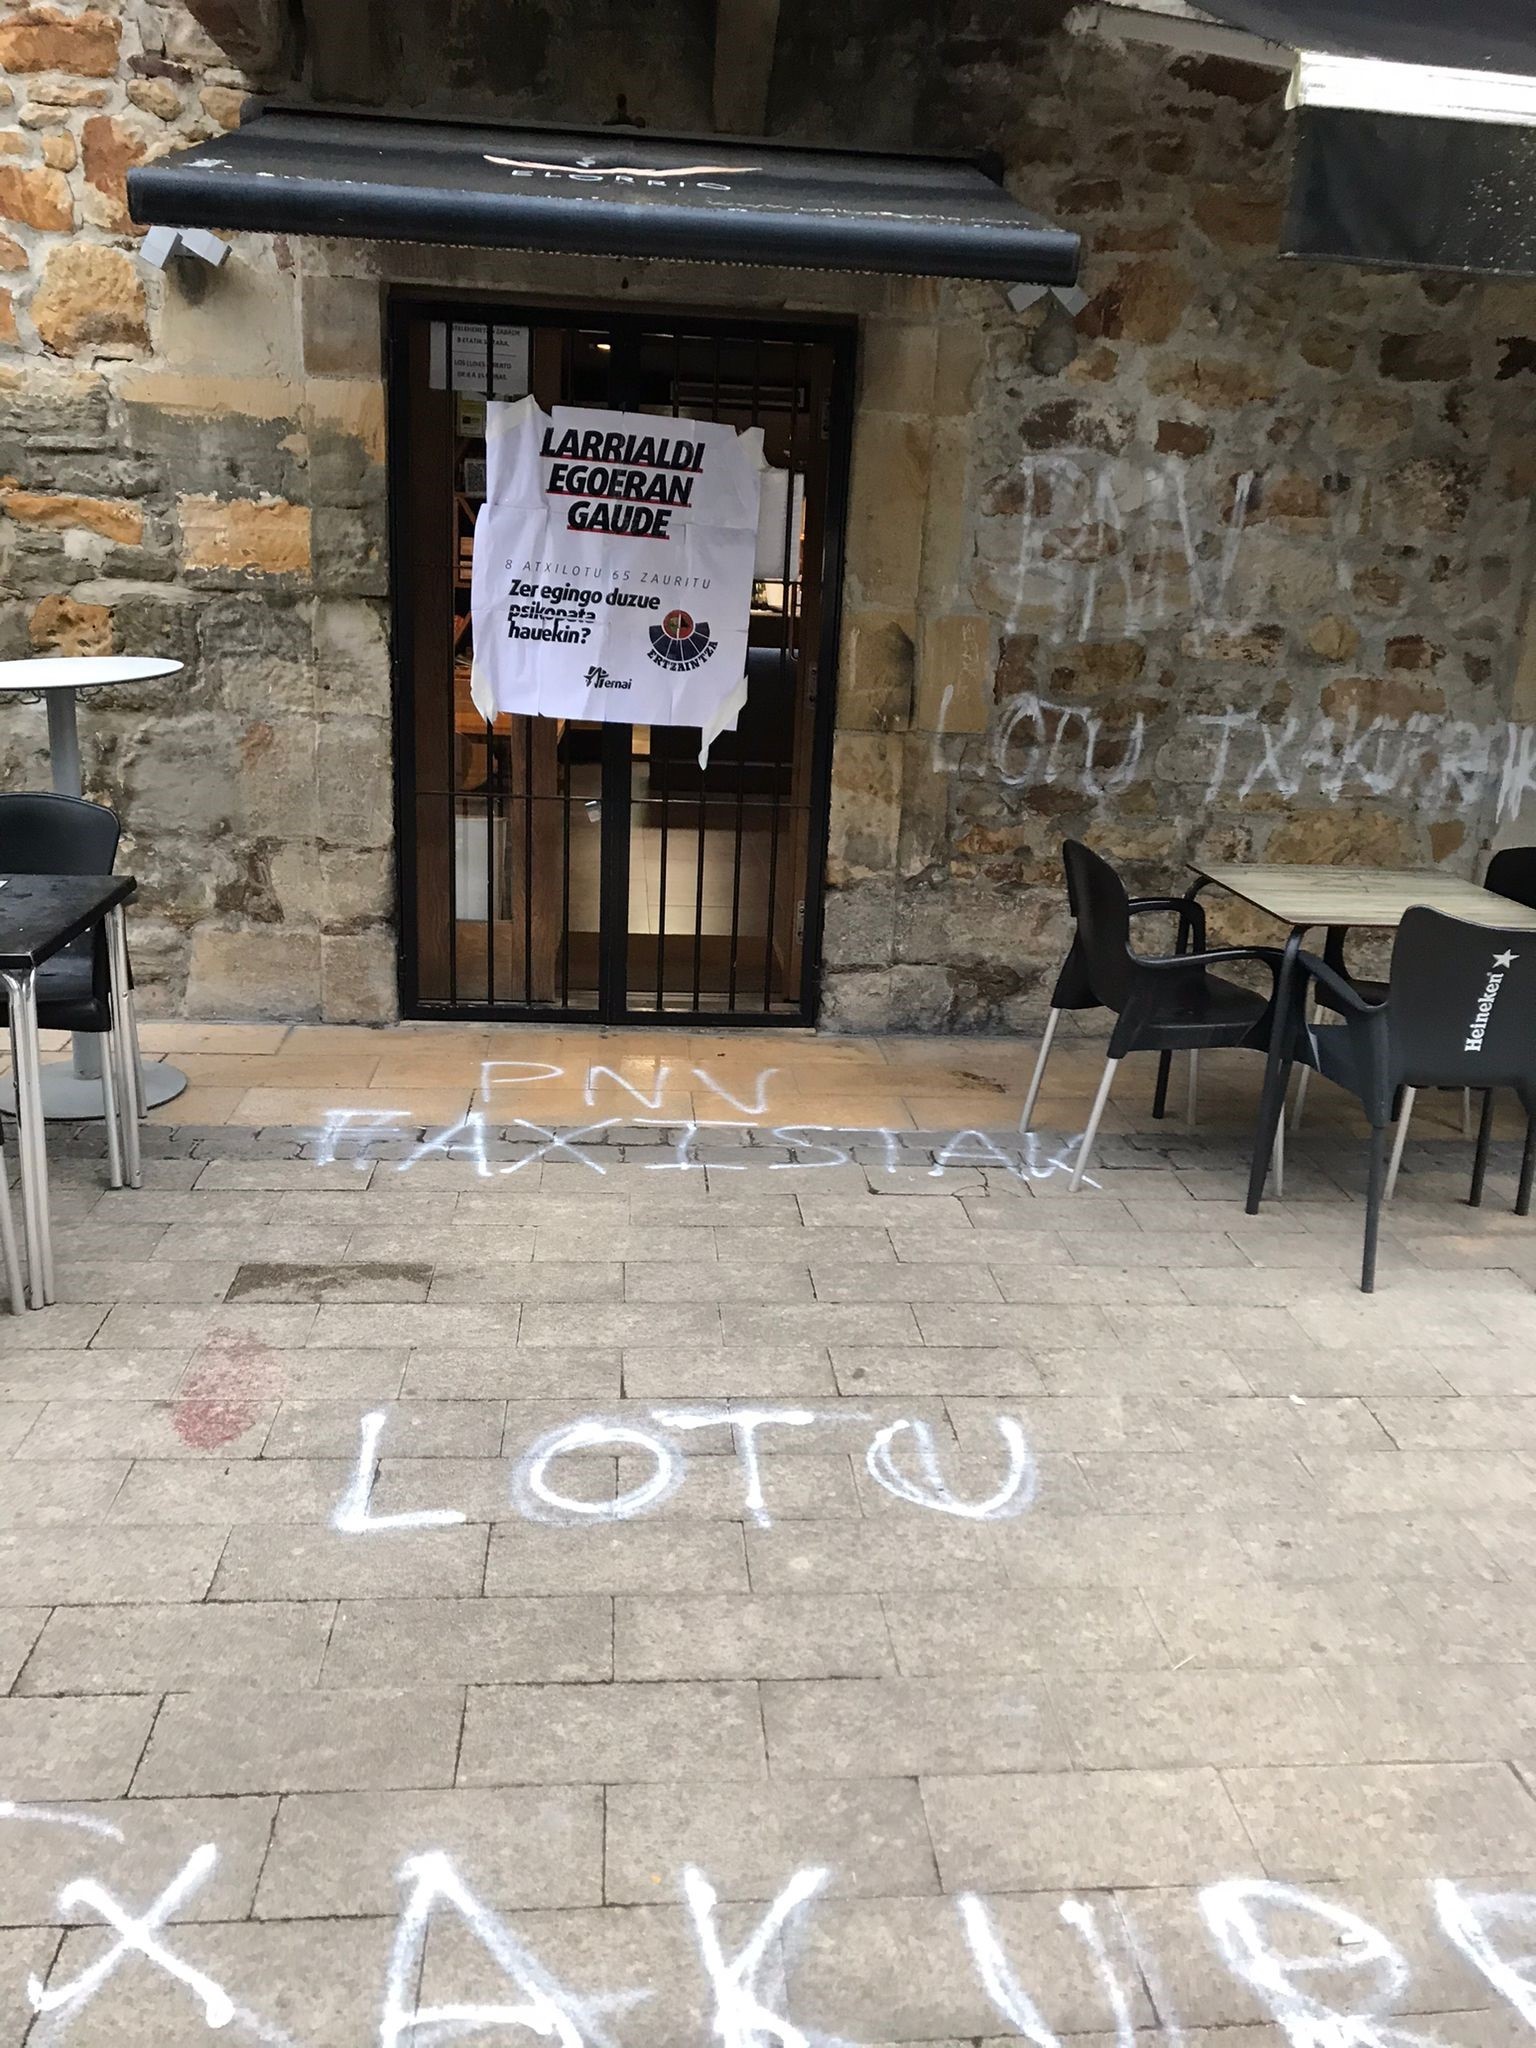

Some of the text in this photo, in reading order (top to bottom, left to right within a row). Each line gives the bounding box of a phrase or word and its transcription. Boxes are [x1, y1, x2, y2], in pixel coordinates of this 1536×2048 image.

[541, 427, 706, 471] LARRIALDI
[547, 463, 694, 505] EGOERAN
[568, 501, 672, 538] GAUDE
[505, 559, 712, 589] 8 ATXILOTU 65 ZAURITU
[509, 579, 661, 610] Zer egingo duzue
[508, 618, 592, 644] hauekin?
[647, 640, 719, 672] ERTZAINTZA
[1464, 972, 1504, 1052] Heineken
[481, 1060, 780, 1115] PNV
[313, 1108, 1102, 1190] FAXISTAK
[333, 1409, 1038, 1534] LOTU
